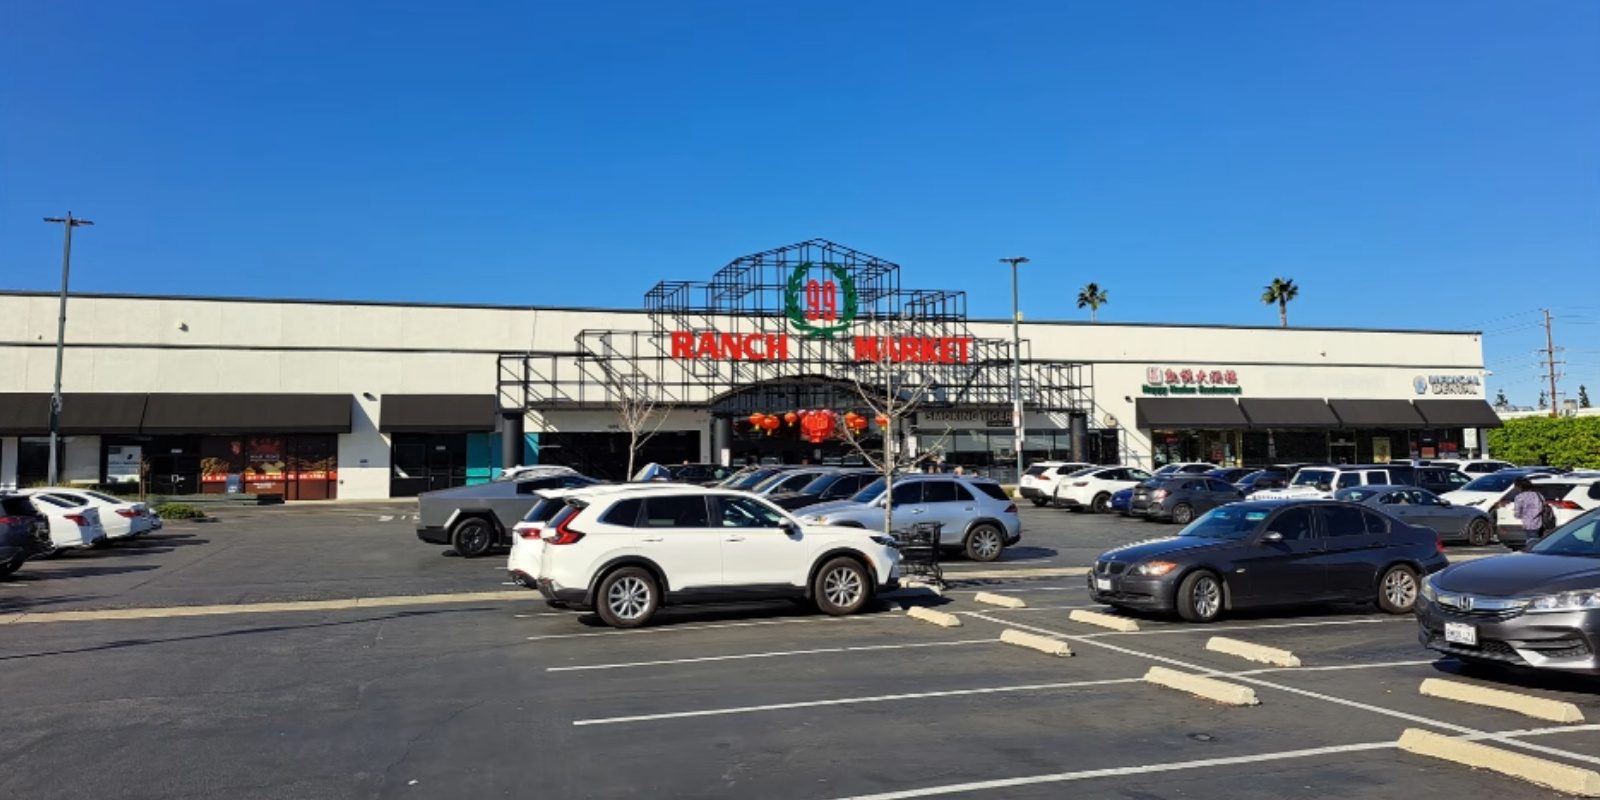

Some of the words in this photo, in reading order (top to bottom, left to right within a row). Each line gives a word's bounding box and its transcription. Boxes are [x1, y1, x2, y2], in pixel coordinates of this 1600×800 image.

[806, 279, 836, 321] 99
[671, 331, 788, 361] RANCH
[854, 336, 972, 364] MARKET
[1429, 375, 1480, 385] MEDICAL
[1432, 383, 1478, 395] DENTAL
[926, 409, 979, 421] SMOKING
